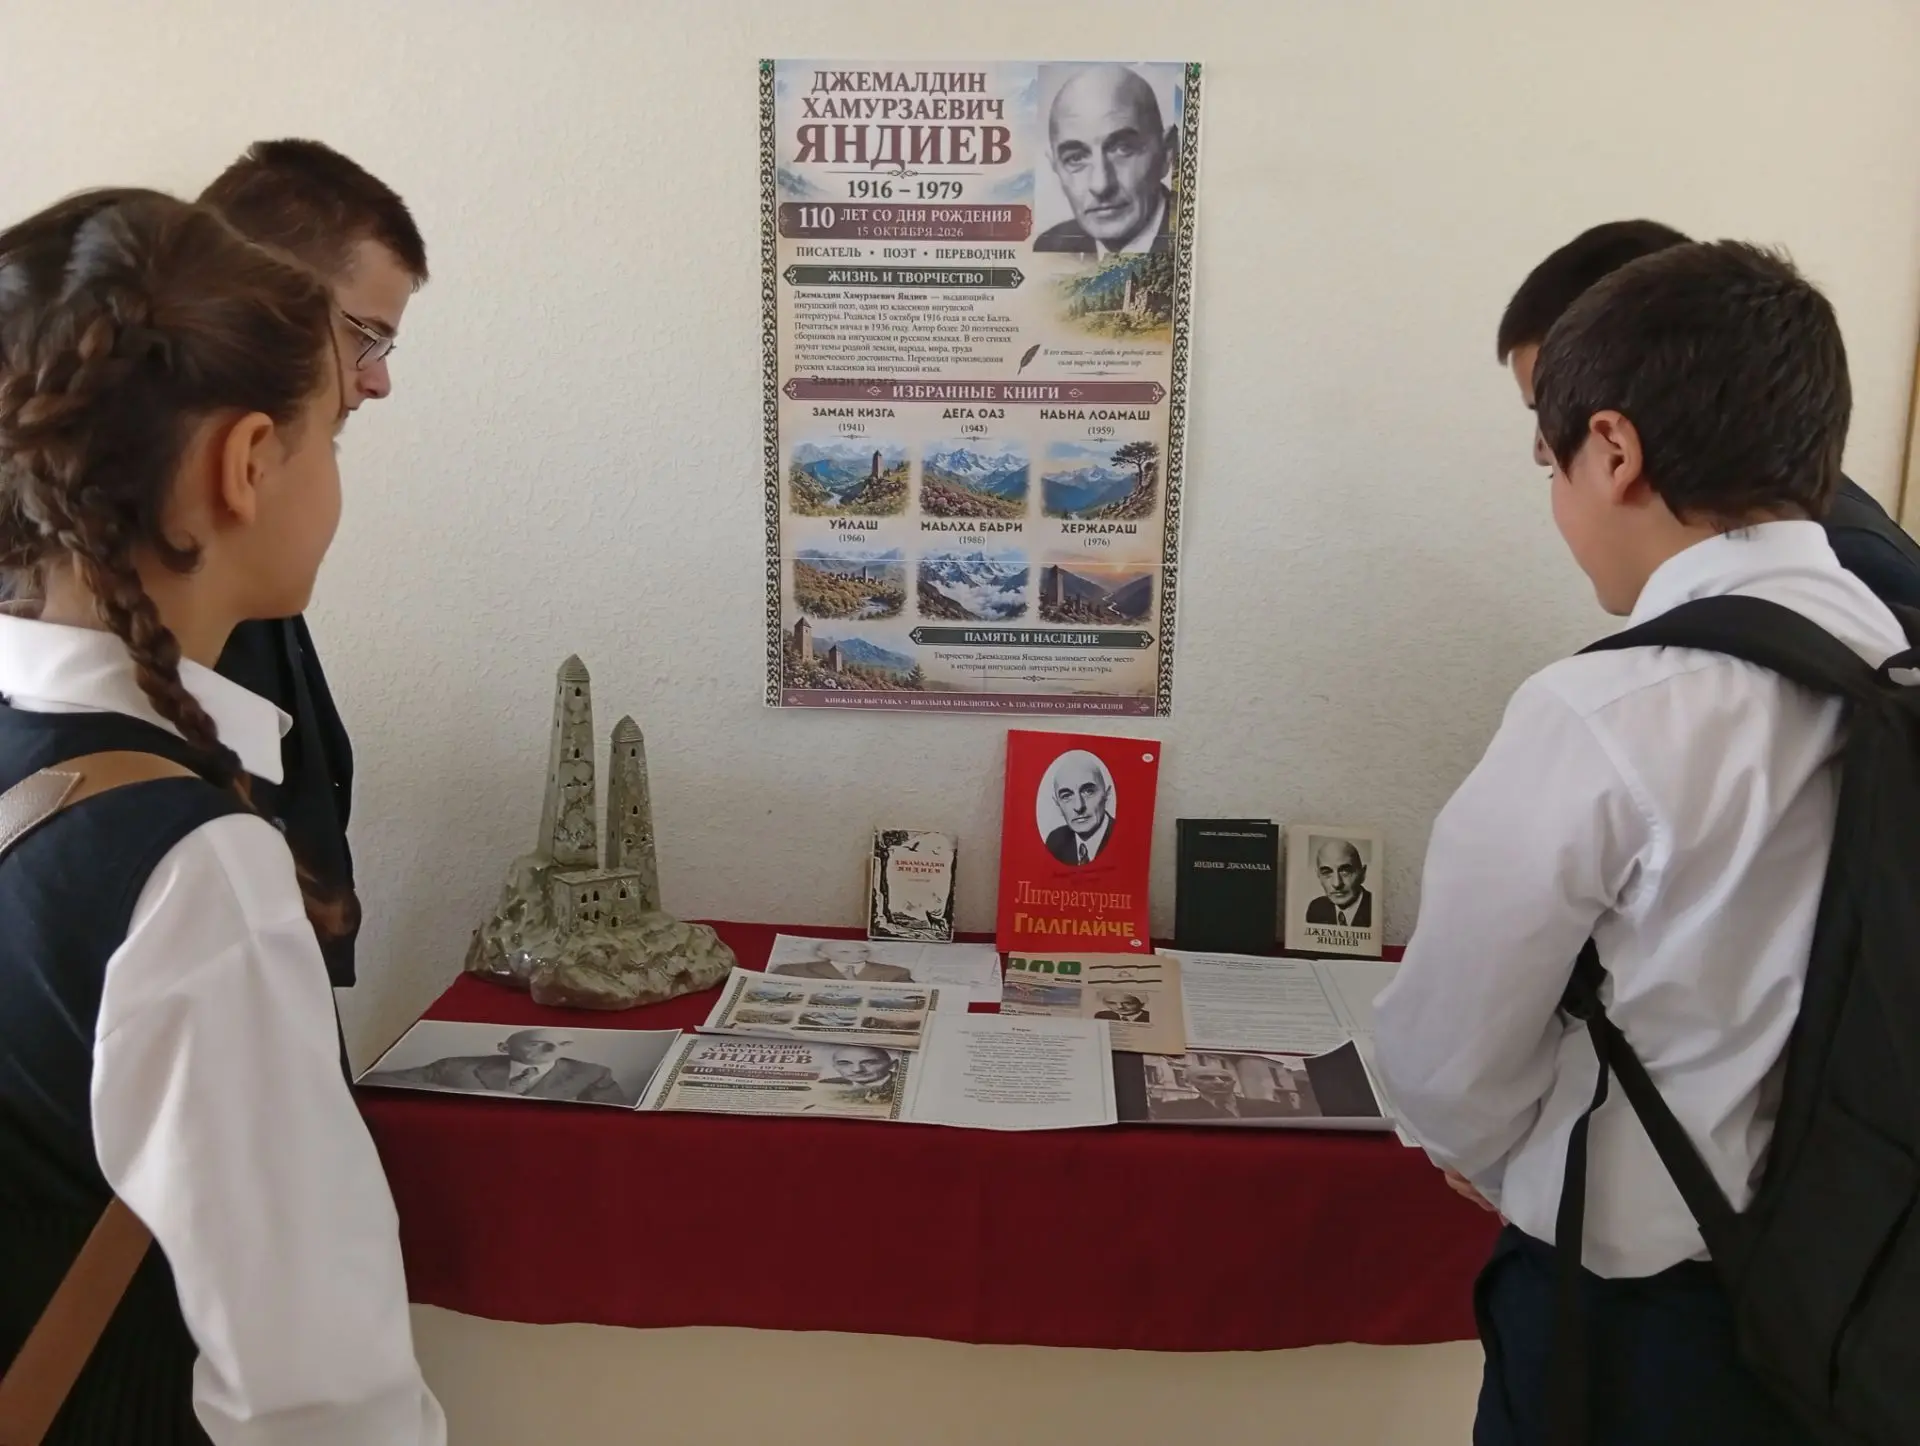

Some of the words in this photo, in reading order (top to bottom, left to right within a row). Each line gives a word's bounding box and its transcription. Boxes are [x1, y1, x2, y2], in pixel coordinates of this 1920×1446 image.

[811, 71, 986, 95] ДЖЕМАЛДИН
[801, 98, 1004, 121] ХАМУРЗАЕВИЧ
[793, 124, 1012, 170] ЯНДИЕВ
[847, 180, 893, 199] 1916
[916, 181, 963, 199] 1979
[798, 206, 835, 229] 110
[840, 207, 869, 222] ЛЕТ
[872, 208, 892, 222] СО
[896, 208, 927, 224] ДНЯ
[931, 209, 1012, 225] РОЖДЕНИЯ
[856, 226, 869, 237] 15
[872, 226, 933, 237] ОКТЯБРЯ
[936, 227, 963, 238] 2026
[796, 246, 861, 259] ПИСАТЕЛЬ
[883, 247, 917, 259] ПОЭТ
[935, 247, 1016, 261] ПЕРЕВОДЧИК
[827, 270, 879, 283] ЖИЗНЬ
[882, 271, 892, 283] И
[898, 271, 984, 285] ТВОРЧЕСТВО
[794, 290, 841, 300] Джемалдин
[843, 291, 895, 301] Хамурзаевич
[897, 292, 928, 301] Яндиев
[794, 302, 837, 311] ингушский
[931, 304, 974, 313] ингушской
[843, 312, 876, 321] Родился
[878, 312, 887, 321] 15
[888, 313, 920, 323] октября
[922, 313, 941, 322] 1916
[794, 321, 838, 331] Печататься
[839, 323, 863, 331] начал
[871, 323, 890, 331] 1936
[911, 324, 935, 334] Автор
[936, 324, 958, 333] более
[960, 324, 970, 333] 20
[971, 325, 1019, 333] поэтических
[794, 332, 836, 341] сборников
[848, 333, 891, 342] ингушском
[900, 335, 931, 343] русском
[795, 343, 819, 351] звучат
[821, 343, 841, 351] темы
[842, 343, 870, 352] родной
[951, 345, 973, 354] труда
[801, 353, 856, 361] человеческого
[907, 355, 949, 363] Переводил
[950, 355, 1004, 363] произведения
[794, 363, 825, 372] русских
[877, 363, 920, 373] ингушский
[892, 385, 996, 399] ИЗБРАННЫЕ
[1003, 386, 1060, 399] КНИГИ
[812, 407, 854, 417] ЗАМАН
[857, 408, 896, 418] КИЗГА
[942, 408, 975, 419] ДЕГА
[978, 408, 1005, 419] ОАЗ
[1088, 409, 1151, 421] ЛОАМАШ
[838, 423, 865, 433] (1941)
[1087, 426, 1115, 435] (1959)
[829, 518, 879, 531] УЙЛАШ
[838, 533, 866, 543] (1966)
[1083, 536, 1111, 547] (1976)
[963, 632, 1017, 643] ПАМЯТЬ
[1020, 632, 1029, 643] И
[1033, 633, 1100, 645] НАСЛЕДИЕ
[934, 652, 974, 662] Творчество
[1022, 653, 1053, 663] Яндиева
[1088, 654, 1112, 664] особое
[1113, 656, 1135, 664] место
[956, 663, 987, 672] истории
[987, 663, 1027, 673] ингушской
[1028, 664, 1071, 673] литературы
[953, 700, 1000, 708] БИБЛИОТЕКА
[1083, 703, 1124, 711] РОЖДЕНИЯ
[897, 866, 941, 874] ЯНДИЕВ
[1304, 926, 1372, 941] ДЖЕМАЛДИН
[1316, 936, 1360, 947] ЯНДИЕВ
[698, 1052, 813, 1065] ЯНДИЕВ
